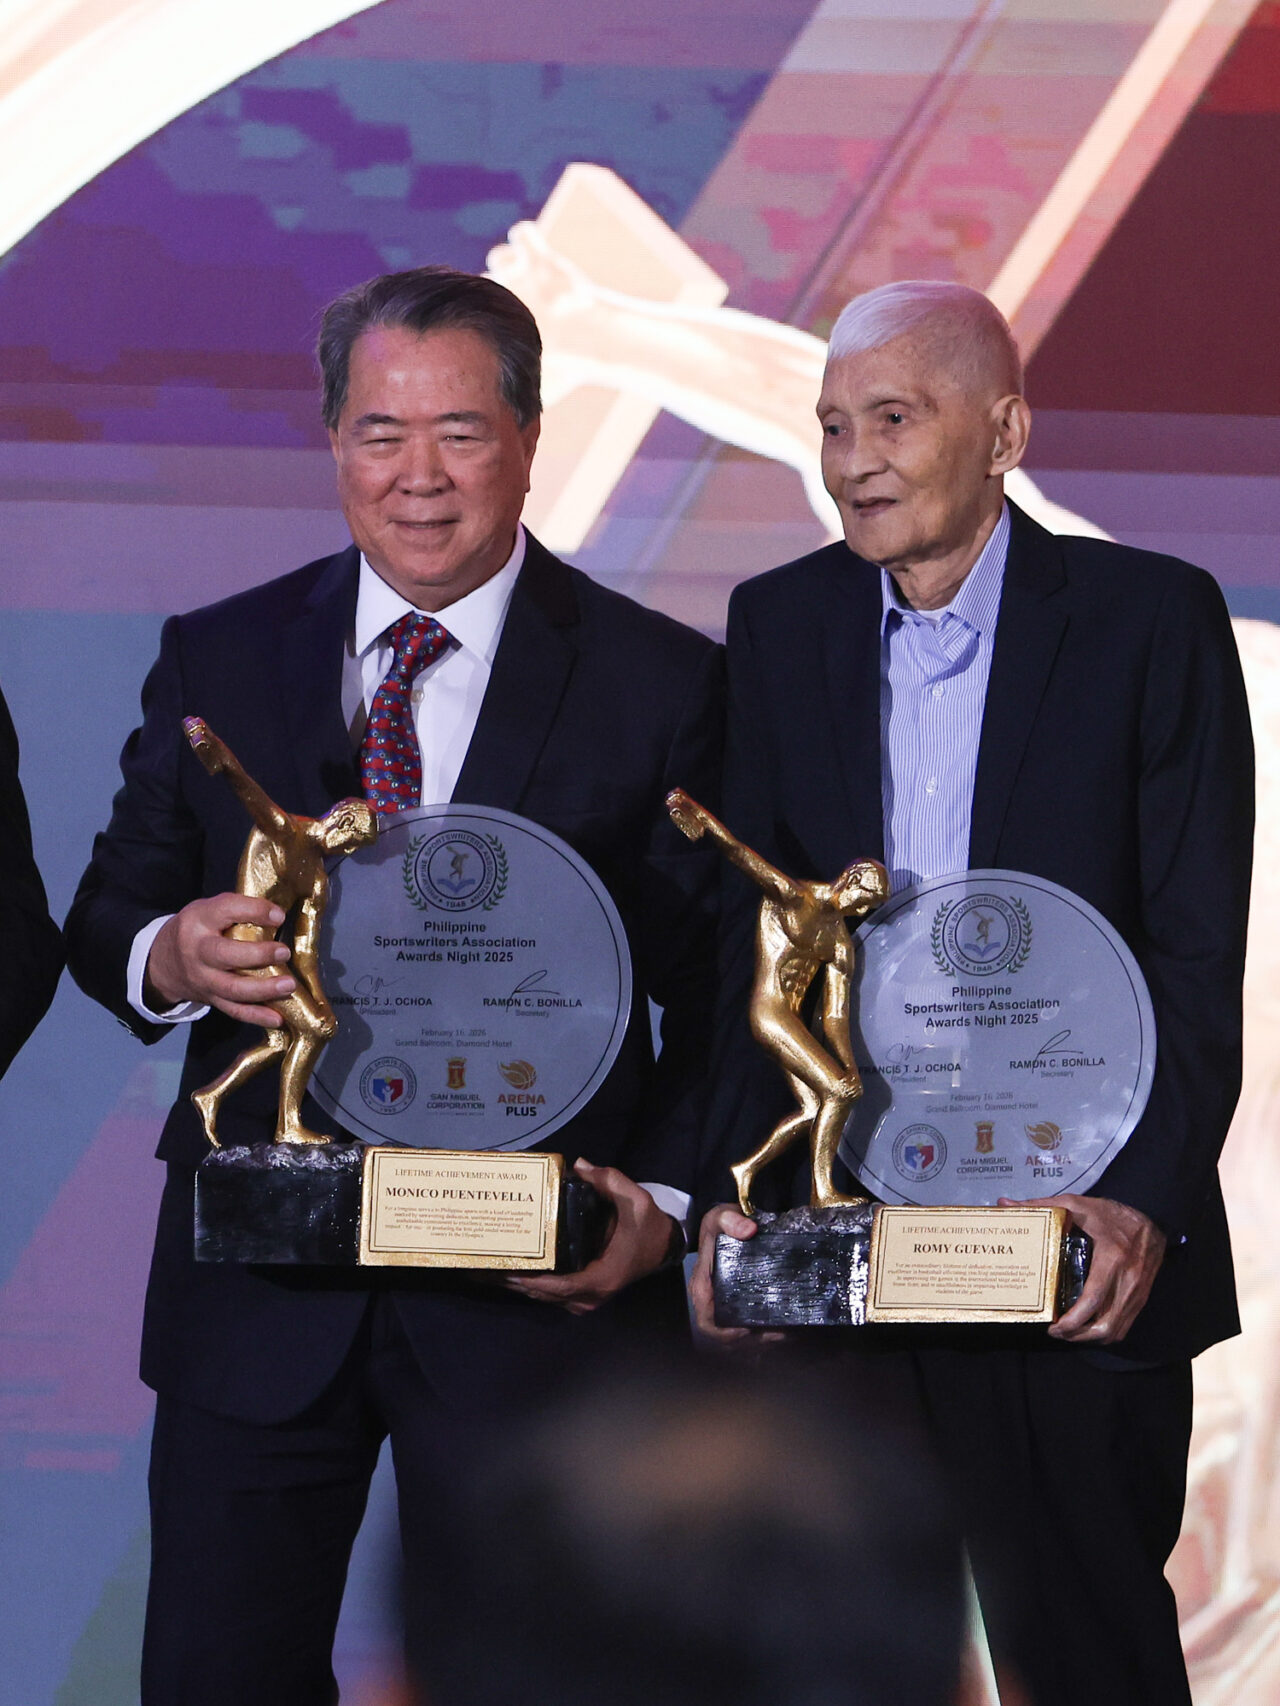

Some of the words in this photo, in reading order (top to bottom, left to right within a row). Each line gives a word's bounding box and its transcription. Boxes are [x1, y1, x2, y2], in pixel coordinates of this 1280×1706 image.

[424, 922, 486, 935] Philippine
[374, 936, 457, 949] Sportswriters
[461, 937, 535, 947] Association
[396, 952, 442, 961] Awards
[447, 952, 479, 964] Night
[484, 952, 513, 961] 2025
[951, 986, 1011, 999] Philippine
[383, 998, 392, 1006] J.
[394, 998, 432, 1006] OCHOA
[483, 999, 521, 1007] RAMON
[537, 999, 582, 1007] BONILLA
[904, 1001, 984, 1016] Sportswriters
[988, 998, 1059, 1010] Association
[925, 1017, 970, 1028] Awards
[974, 1015, 1006, 1029] Night
[1010, 1014, 1038, 1025] 2025
[914, 1065, 922, 1073] J.
[924, 1063, 961, 1073] OCHOA
[1009, 1059, 1046, 1069] RAMON
[1061, 1058, 1105, 1067] BONILLA
[497, 1094, 545, 1104] ARENA
[506, 1107, 536, 1116] PLUS
[395, 1169, 433, 1177] LIFETIME
[435, 1170, 495, 1179] ACHIEVEMENT
[496, 1172, 527, 1180] AWARD
[956, 1166, 1015, 1174] CORPORATION
[1033, 1168, 1063, 1177] PLUS
[386, 1188, 438, 1198] MONICO
[442, 1189, 533, 1202] PUENTEVELLA
[913, 1244, 951, 1253] ROMY
[954, 1244, 1013, 1254] GUEVARA
